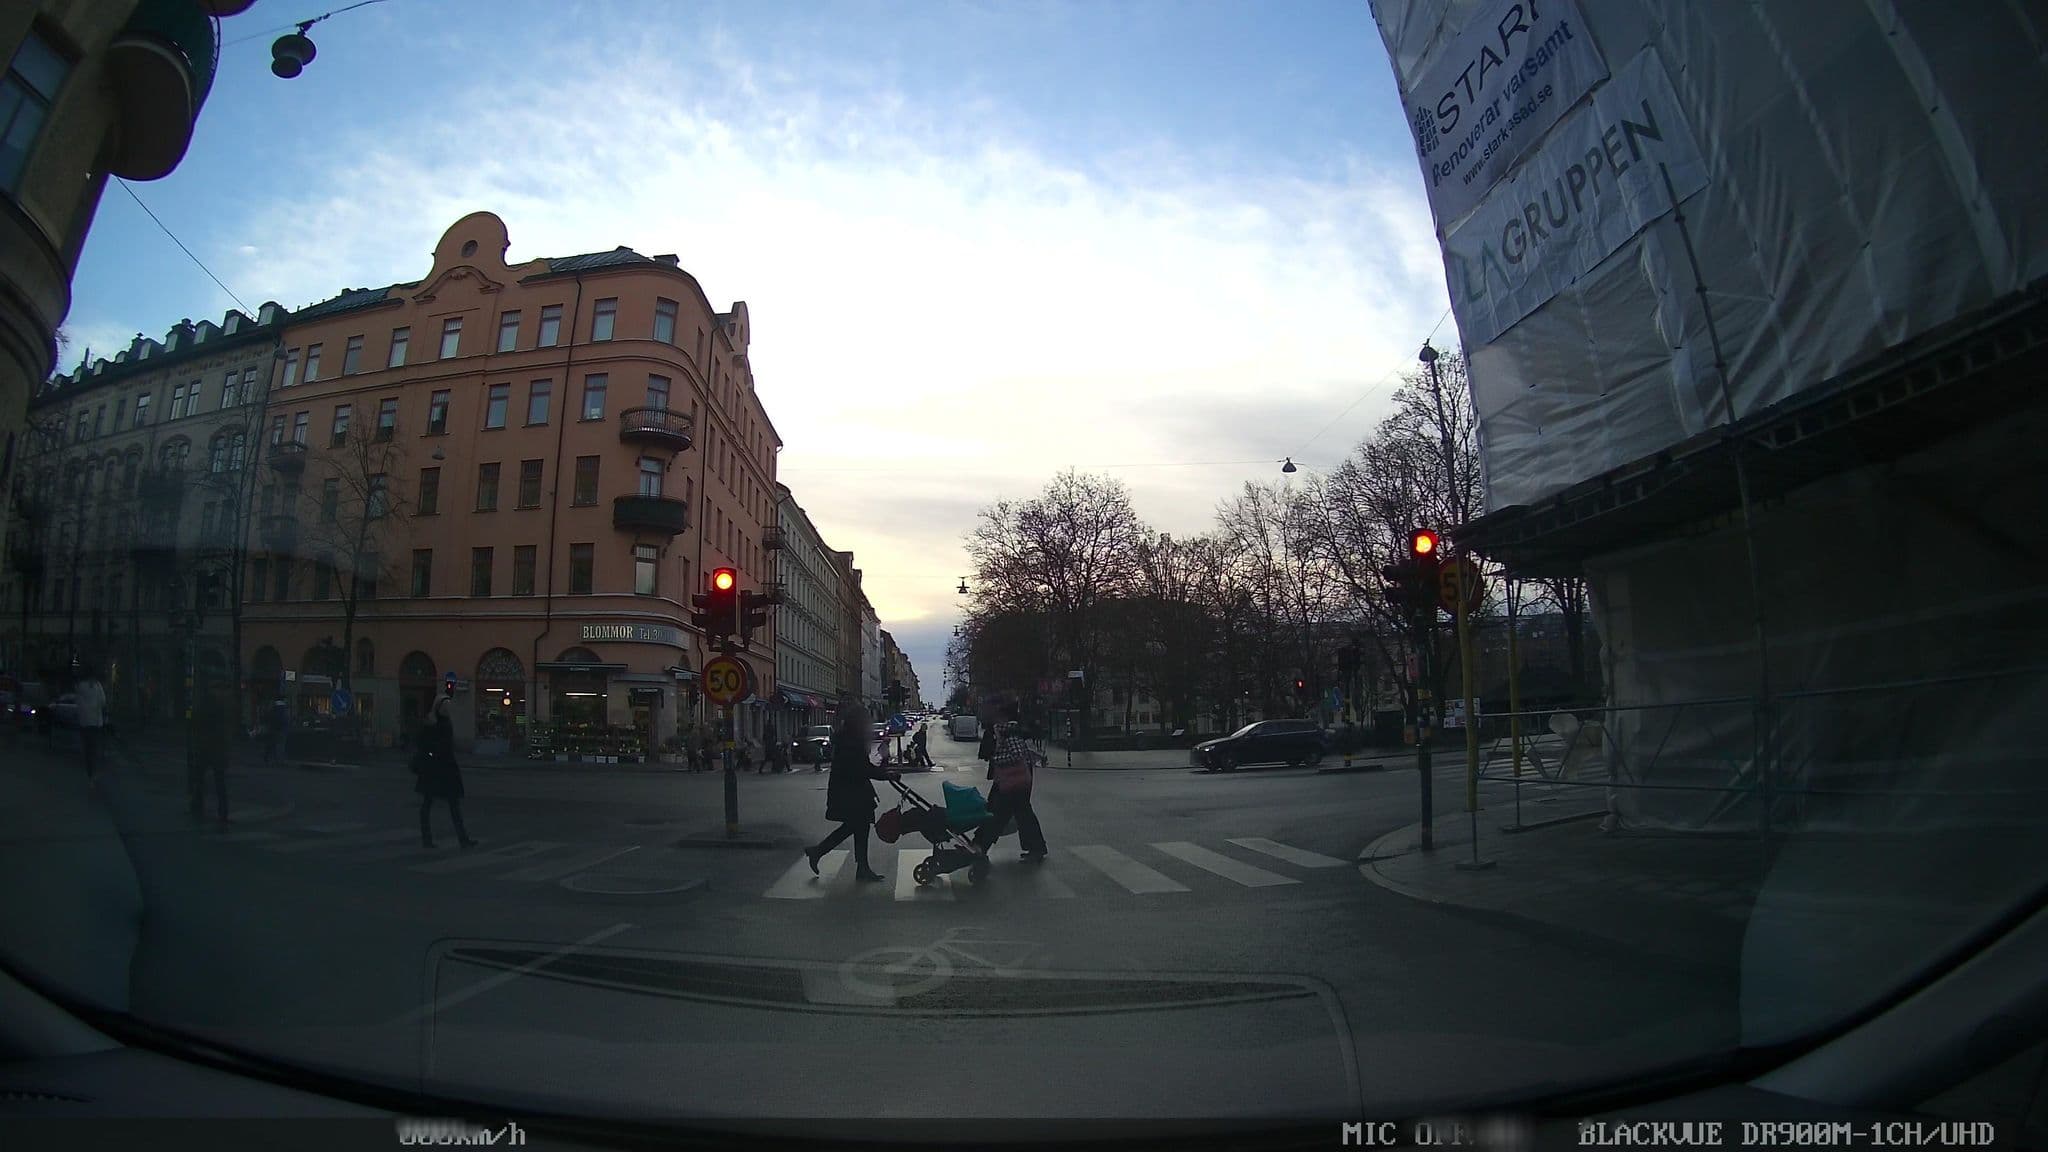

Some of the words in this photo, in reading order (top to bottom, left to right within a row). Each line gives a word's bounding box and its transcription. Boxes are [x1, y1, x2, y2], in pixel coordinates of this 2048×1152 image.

[1432, 97, 1502, 187] Renoverar
[1502, 19, 1574, 102] varsamt
[583, 624, 633, 639] BLOMMOR
[709, 669, 741, 692] 50
